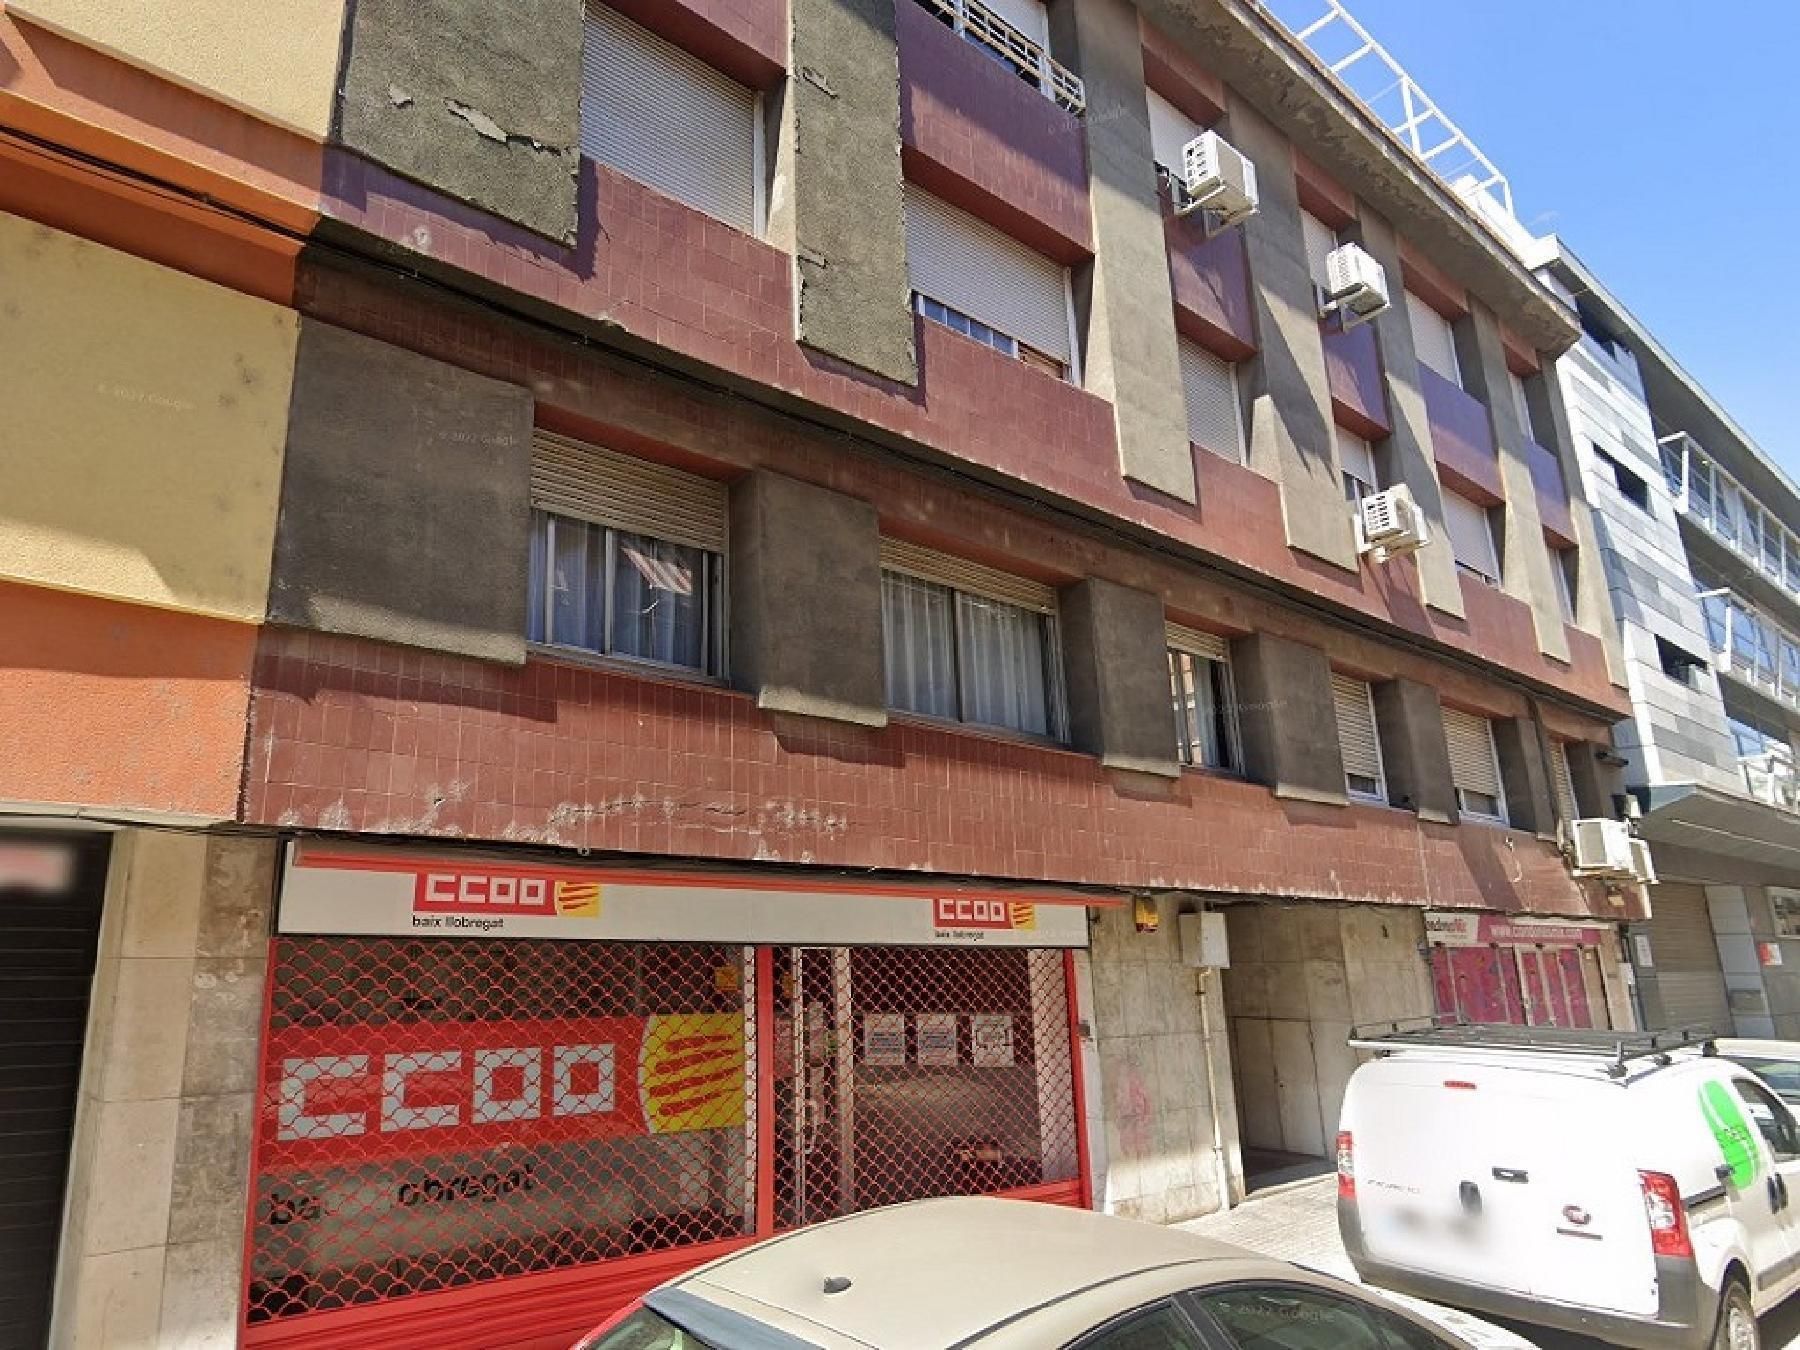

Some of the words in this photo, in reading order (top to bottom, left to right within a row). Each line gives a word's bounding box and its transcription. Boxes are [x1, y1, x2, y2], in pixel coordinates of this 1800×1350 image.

[425, 874, 547, 906] CCOO
[412, 915, 442, 928] baix
[445, 916, 504, 932] llobregat
[939, 899, 1005, 922] CCOO
[277, 1044, 616, 1141] CCOO
